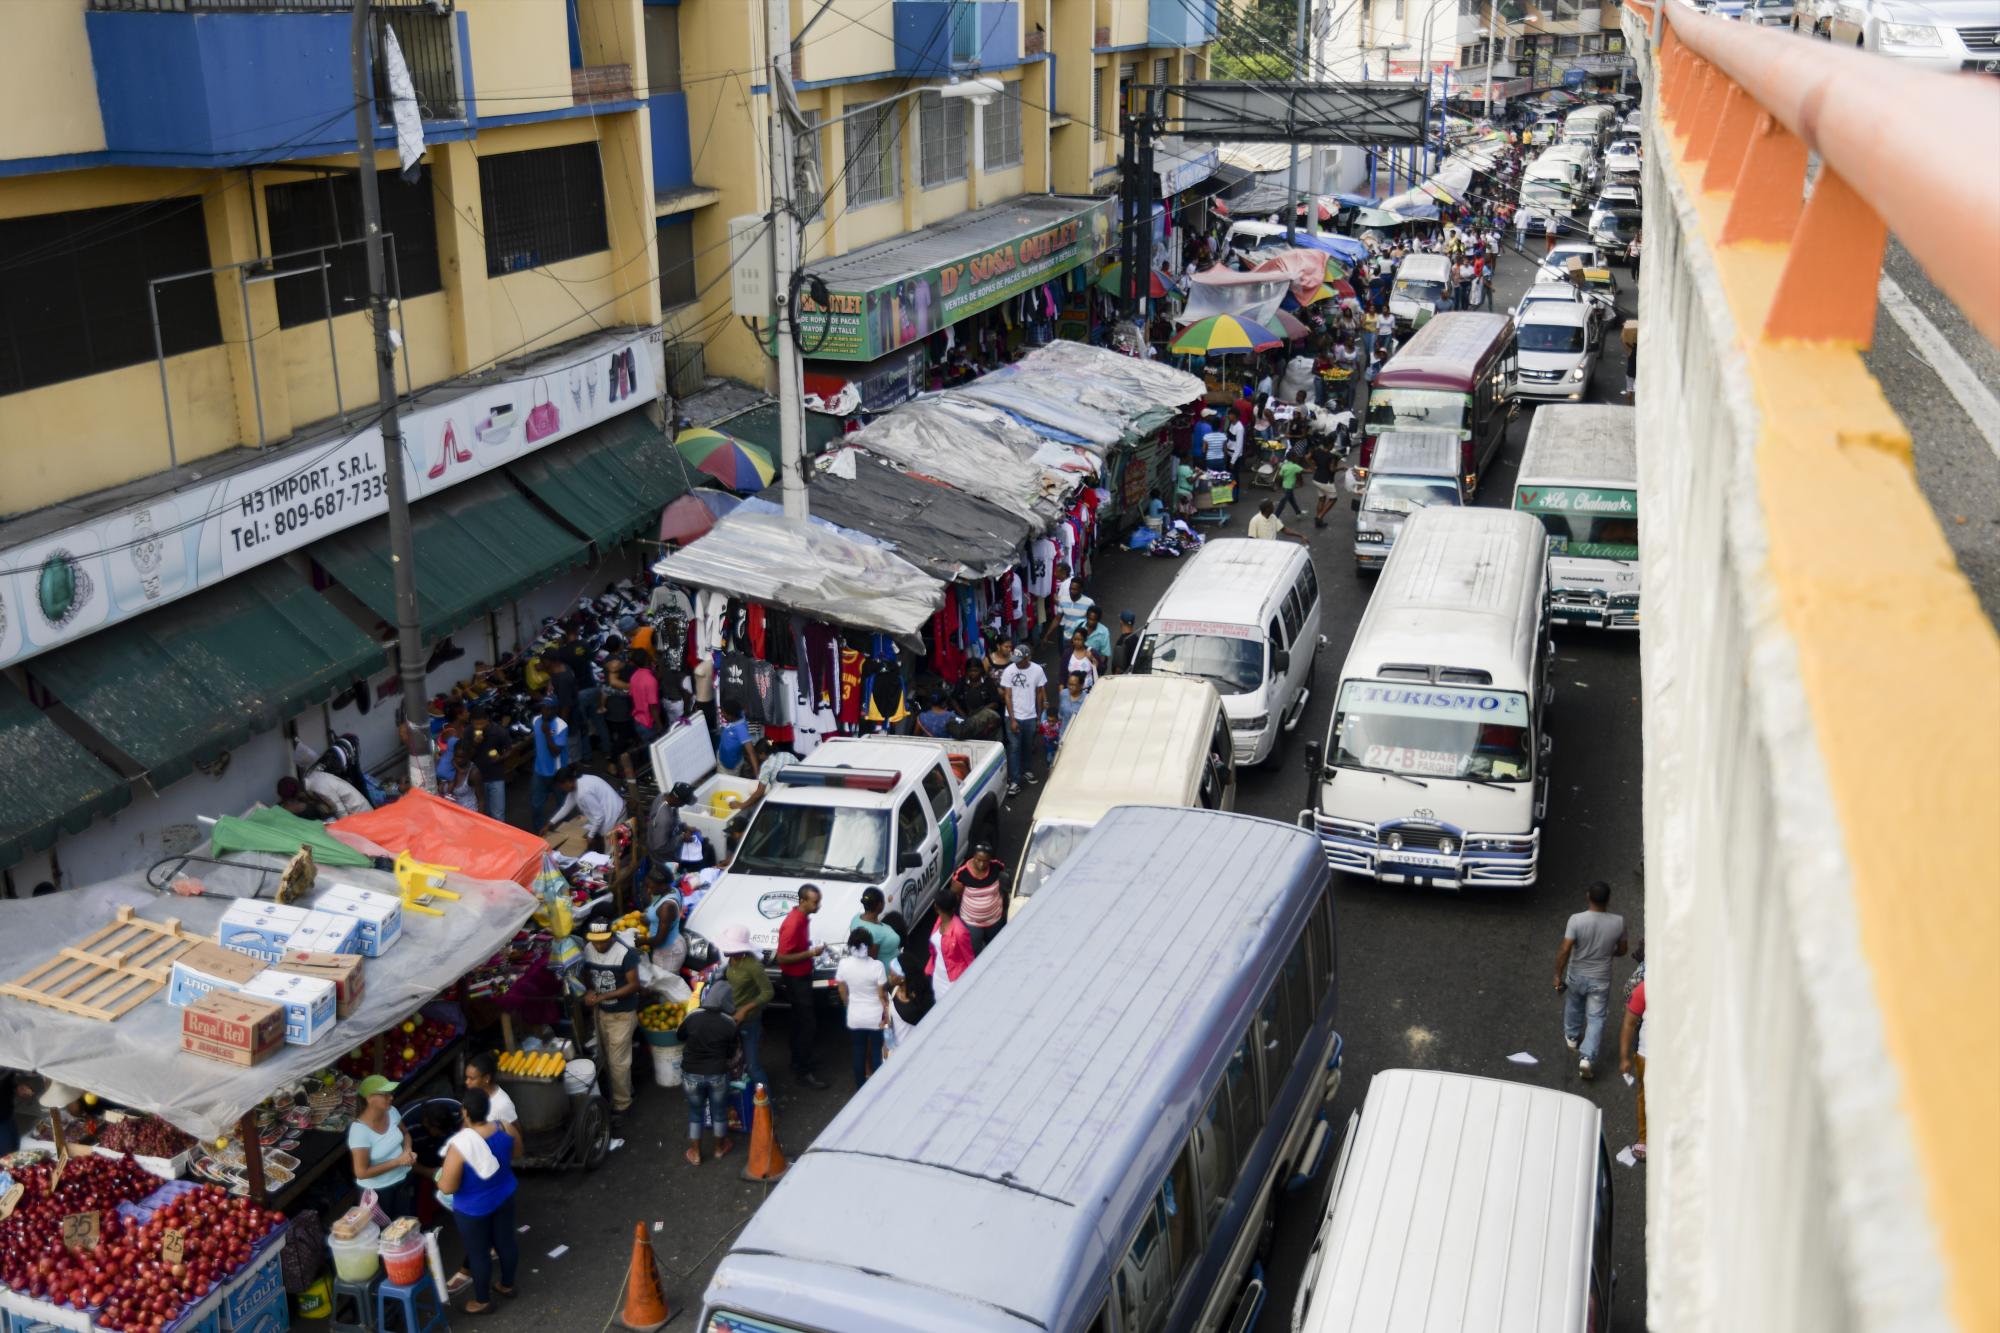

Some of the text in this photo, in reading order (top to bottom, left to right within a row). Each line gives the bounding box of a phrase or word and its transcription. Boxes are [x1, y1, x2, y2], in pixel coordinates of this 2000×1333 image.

[969, 245, 1016, 286] SOSA
[1019, 219, 1078, 264] OUTLET
[944, 295, 969, 312] VENTAS
[969, 290, 978, 302] DE
[978, 282, 996, 297] ROPAS
[996, 278, 1005, 290] DE
[1004, 271, 1021, 286] PACAS
[1028, 263, 1039, 275] POR
[1039, 256, 1055, 272] MAYOR
[1059, 247, 1078, 261] DETALLE
[802, 325, 824, 333] MAYOR
[810, 316, 828, 324] ROPA
[840, 317, 860, 326] PACAS
[241, 452, 377, 517] H3 IMPORT, S.R.L.
[231, 520, 271, 552] Tel.:
[1364, 686, 1500, 711] TURISMO
[1368, 745, 1416, 770] 27-B
[1416, 760, 1456, 775] PARQUE
[1397, 854, 1440, 865] TOYOTA
[917, 852, 939, 897] AMET
[188, 1012, 245, 1043] Regal Red
[65, 1214, 93, 1240] 35
[166, 1234, 184, 1252] 25
[234, 1277, 277, 1317] TROUT
